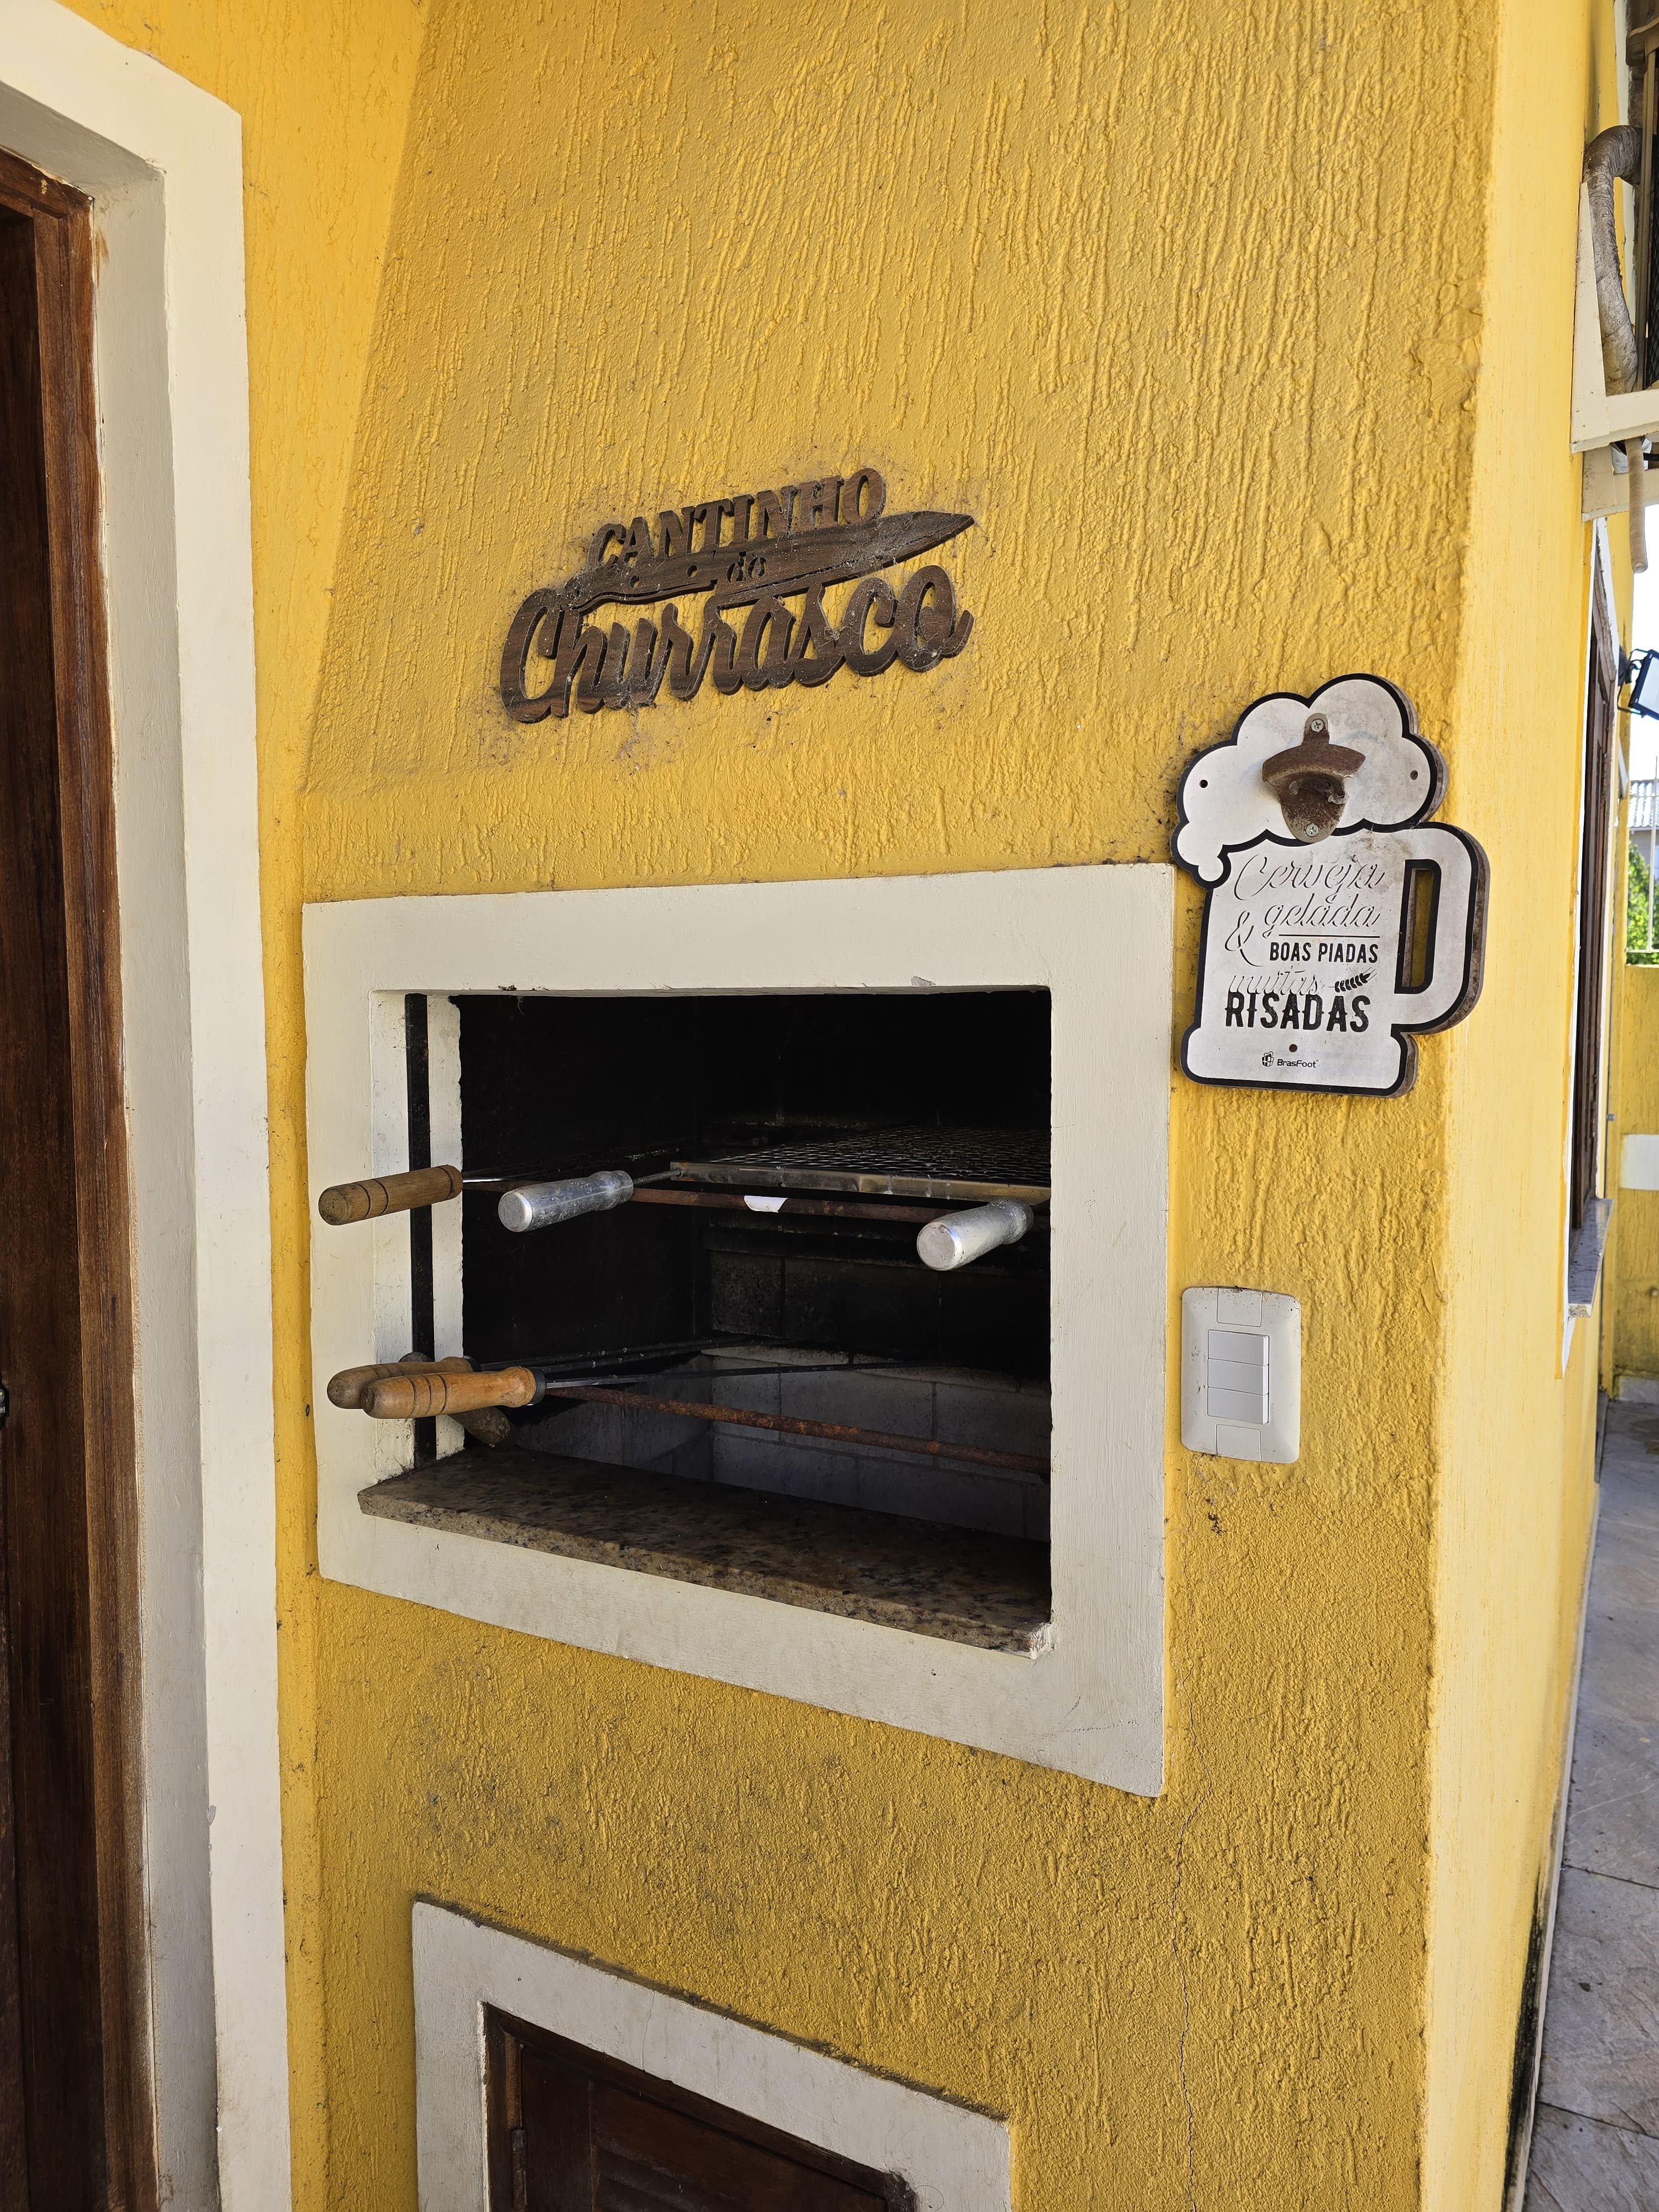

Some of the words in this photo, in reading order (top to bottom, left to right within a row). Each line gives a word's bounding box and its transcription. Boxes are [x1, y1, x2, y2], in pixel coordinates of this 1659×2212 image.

[588, 467, 886, 567] CANTINHO
[726, 551, 768, 583] do
[500, 565, 974, 723] Churrasco
[1234, 854, 1385, 903] Cerveja
[1262, 893, 1380, 938] gelada
[1224, 910, 1263, 967] &
[1270, 942, 1312, 962] BOAS
[1318, 943, 1379, 964] PIADAS
[1224, 992, 1371, 1032] RISADAS
[1277, 1058, 1317, 1068] BrasFoot
